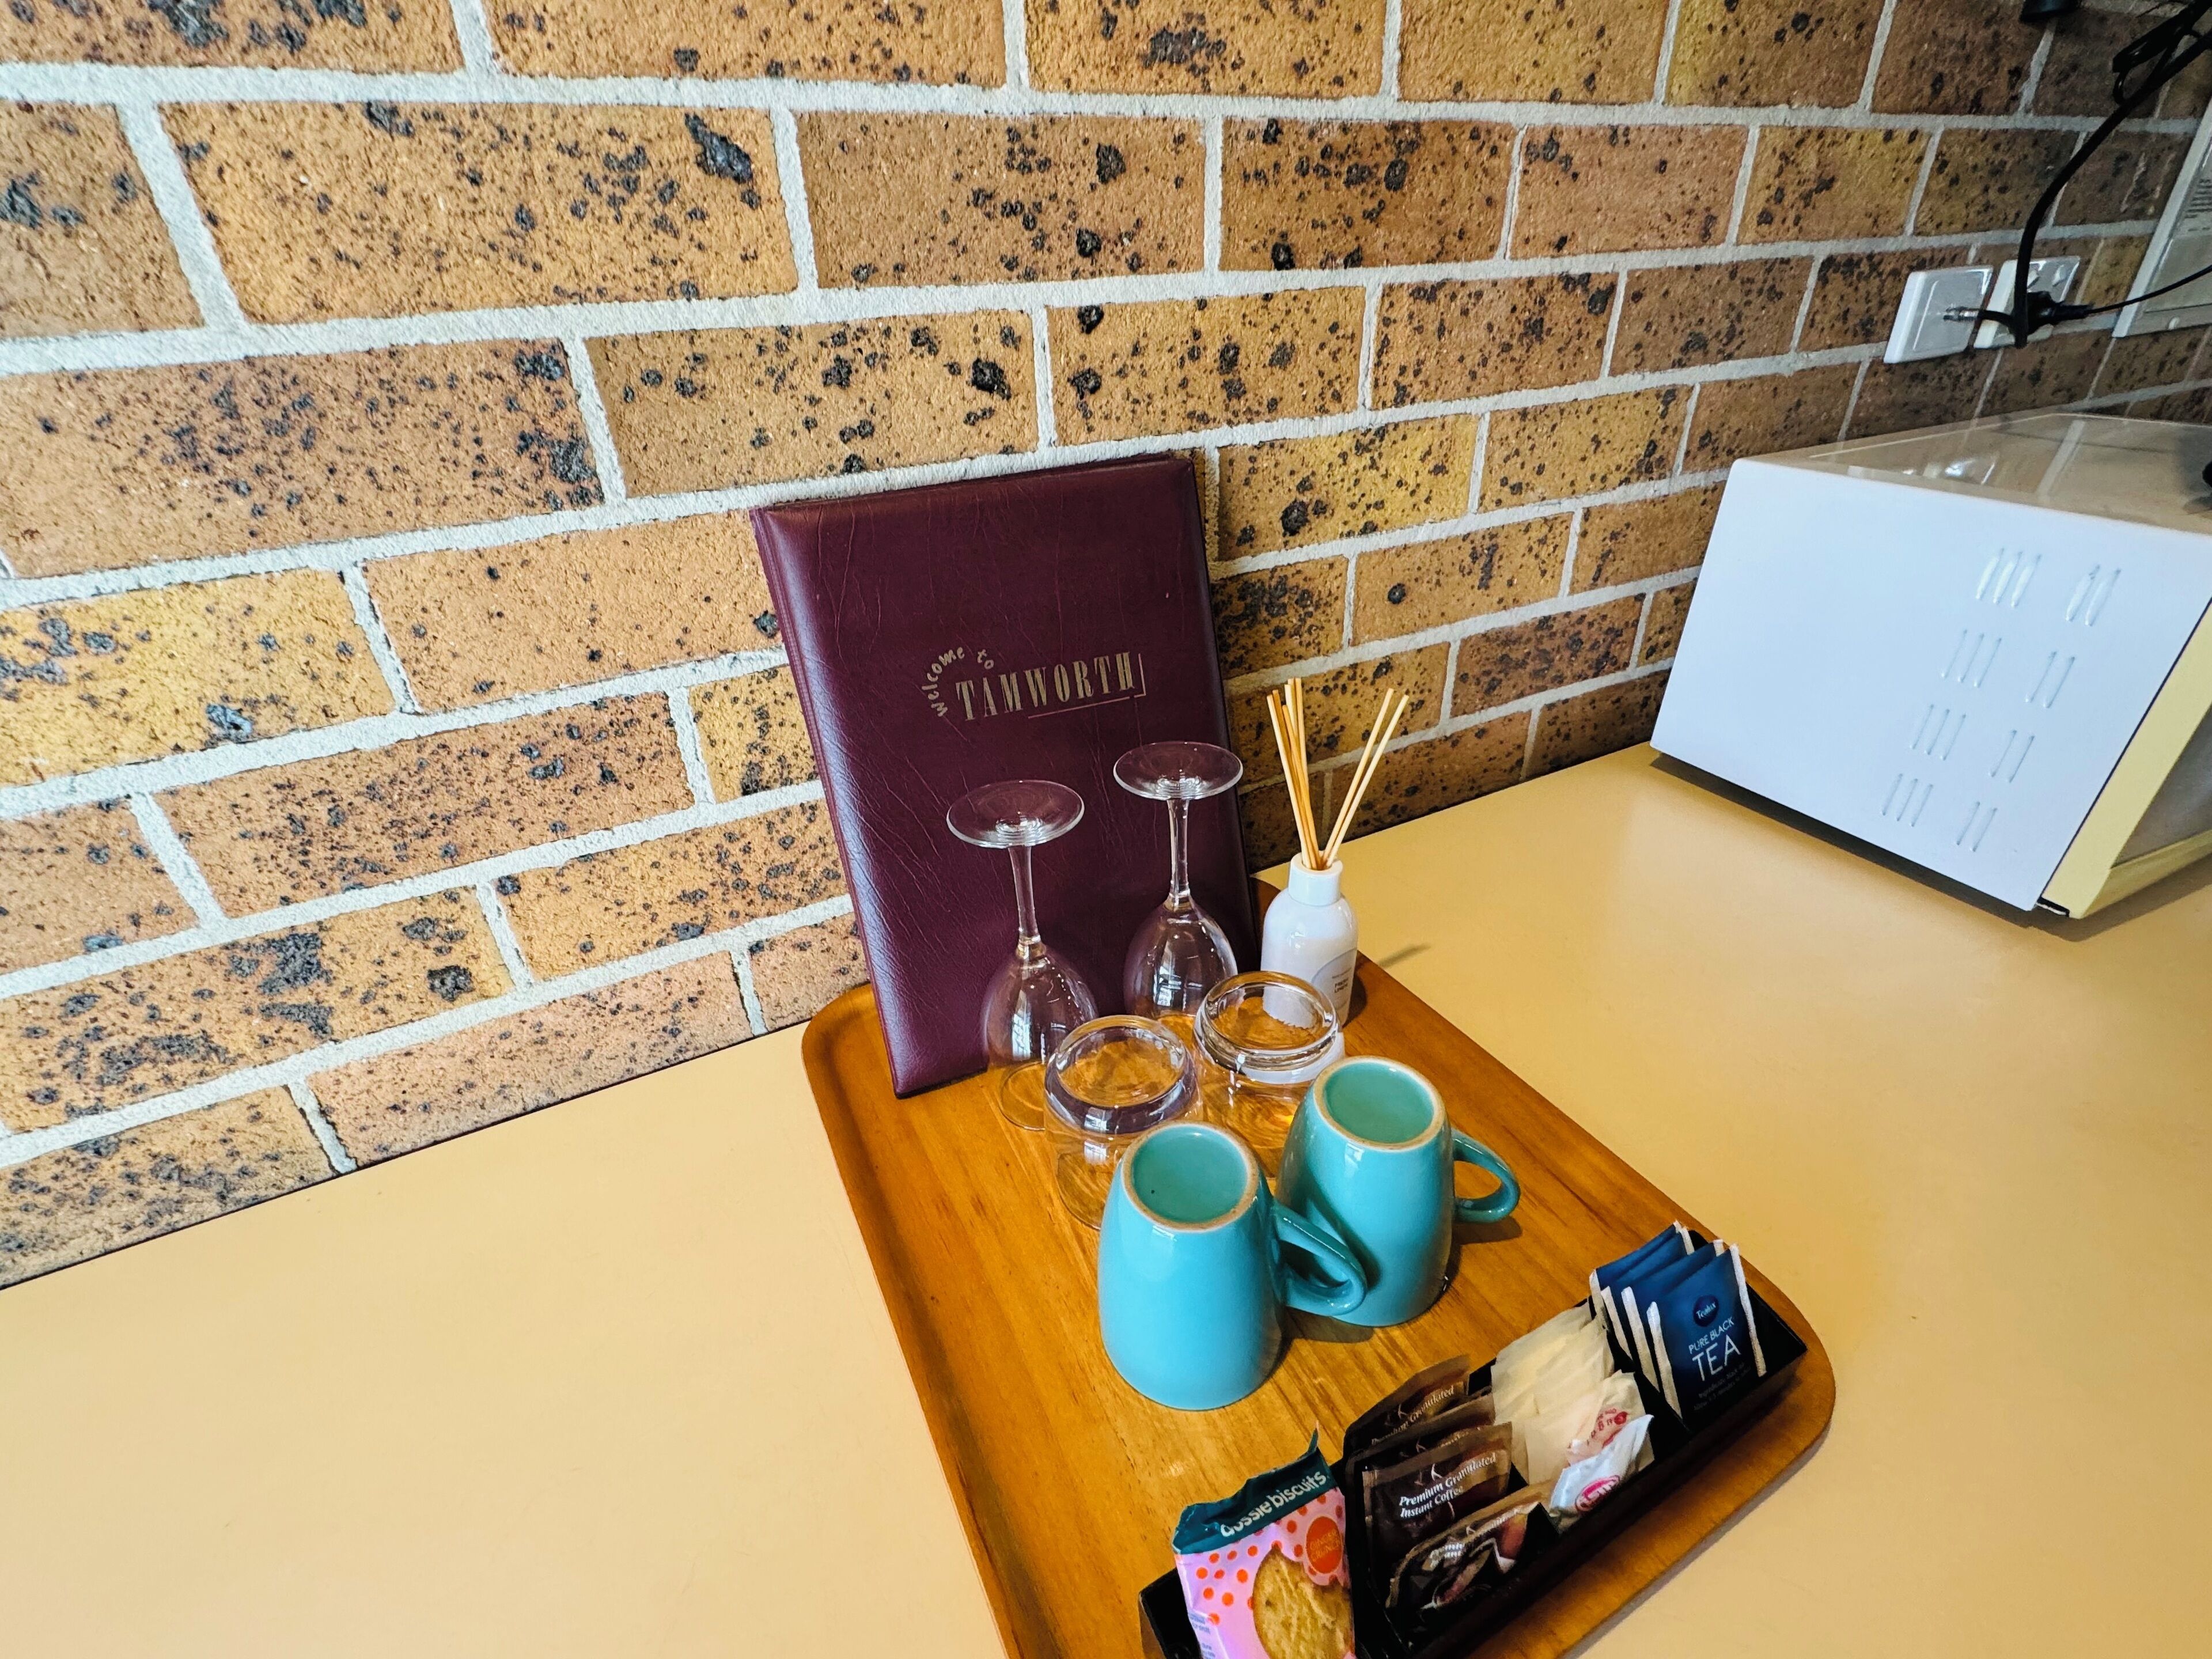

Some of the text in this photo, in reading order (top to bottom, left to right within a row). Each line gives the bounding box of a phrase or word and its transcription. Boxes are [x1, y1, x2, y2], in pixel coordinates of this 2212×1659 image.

[922, 647, 994, 717] welcome to
[955, 652, 1135, 721] TAMWORTH
[1688, 1316, 1734, 1354] PURE BLACK
[1692, 1334, 1742, 1382] TEA
[1266, 1471, 1327, 1509] biscuits
[1399, 1452, 1497, 1506] Premium Granulated
[1400, 1485, 1464, 1518] Instant Coffee
